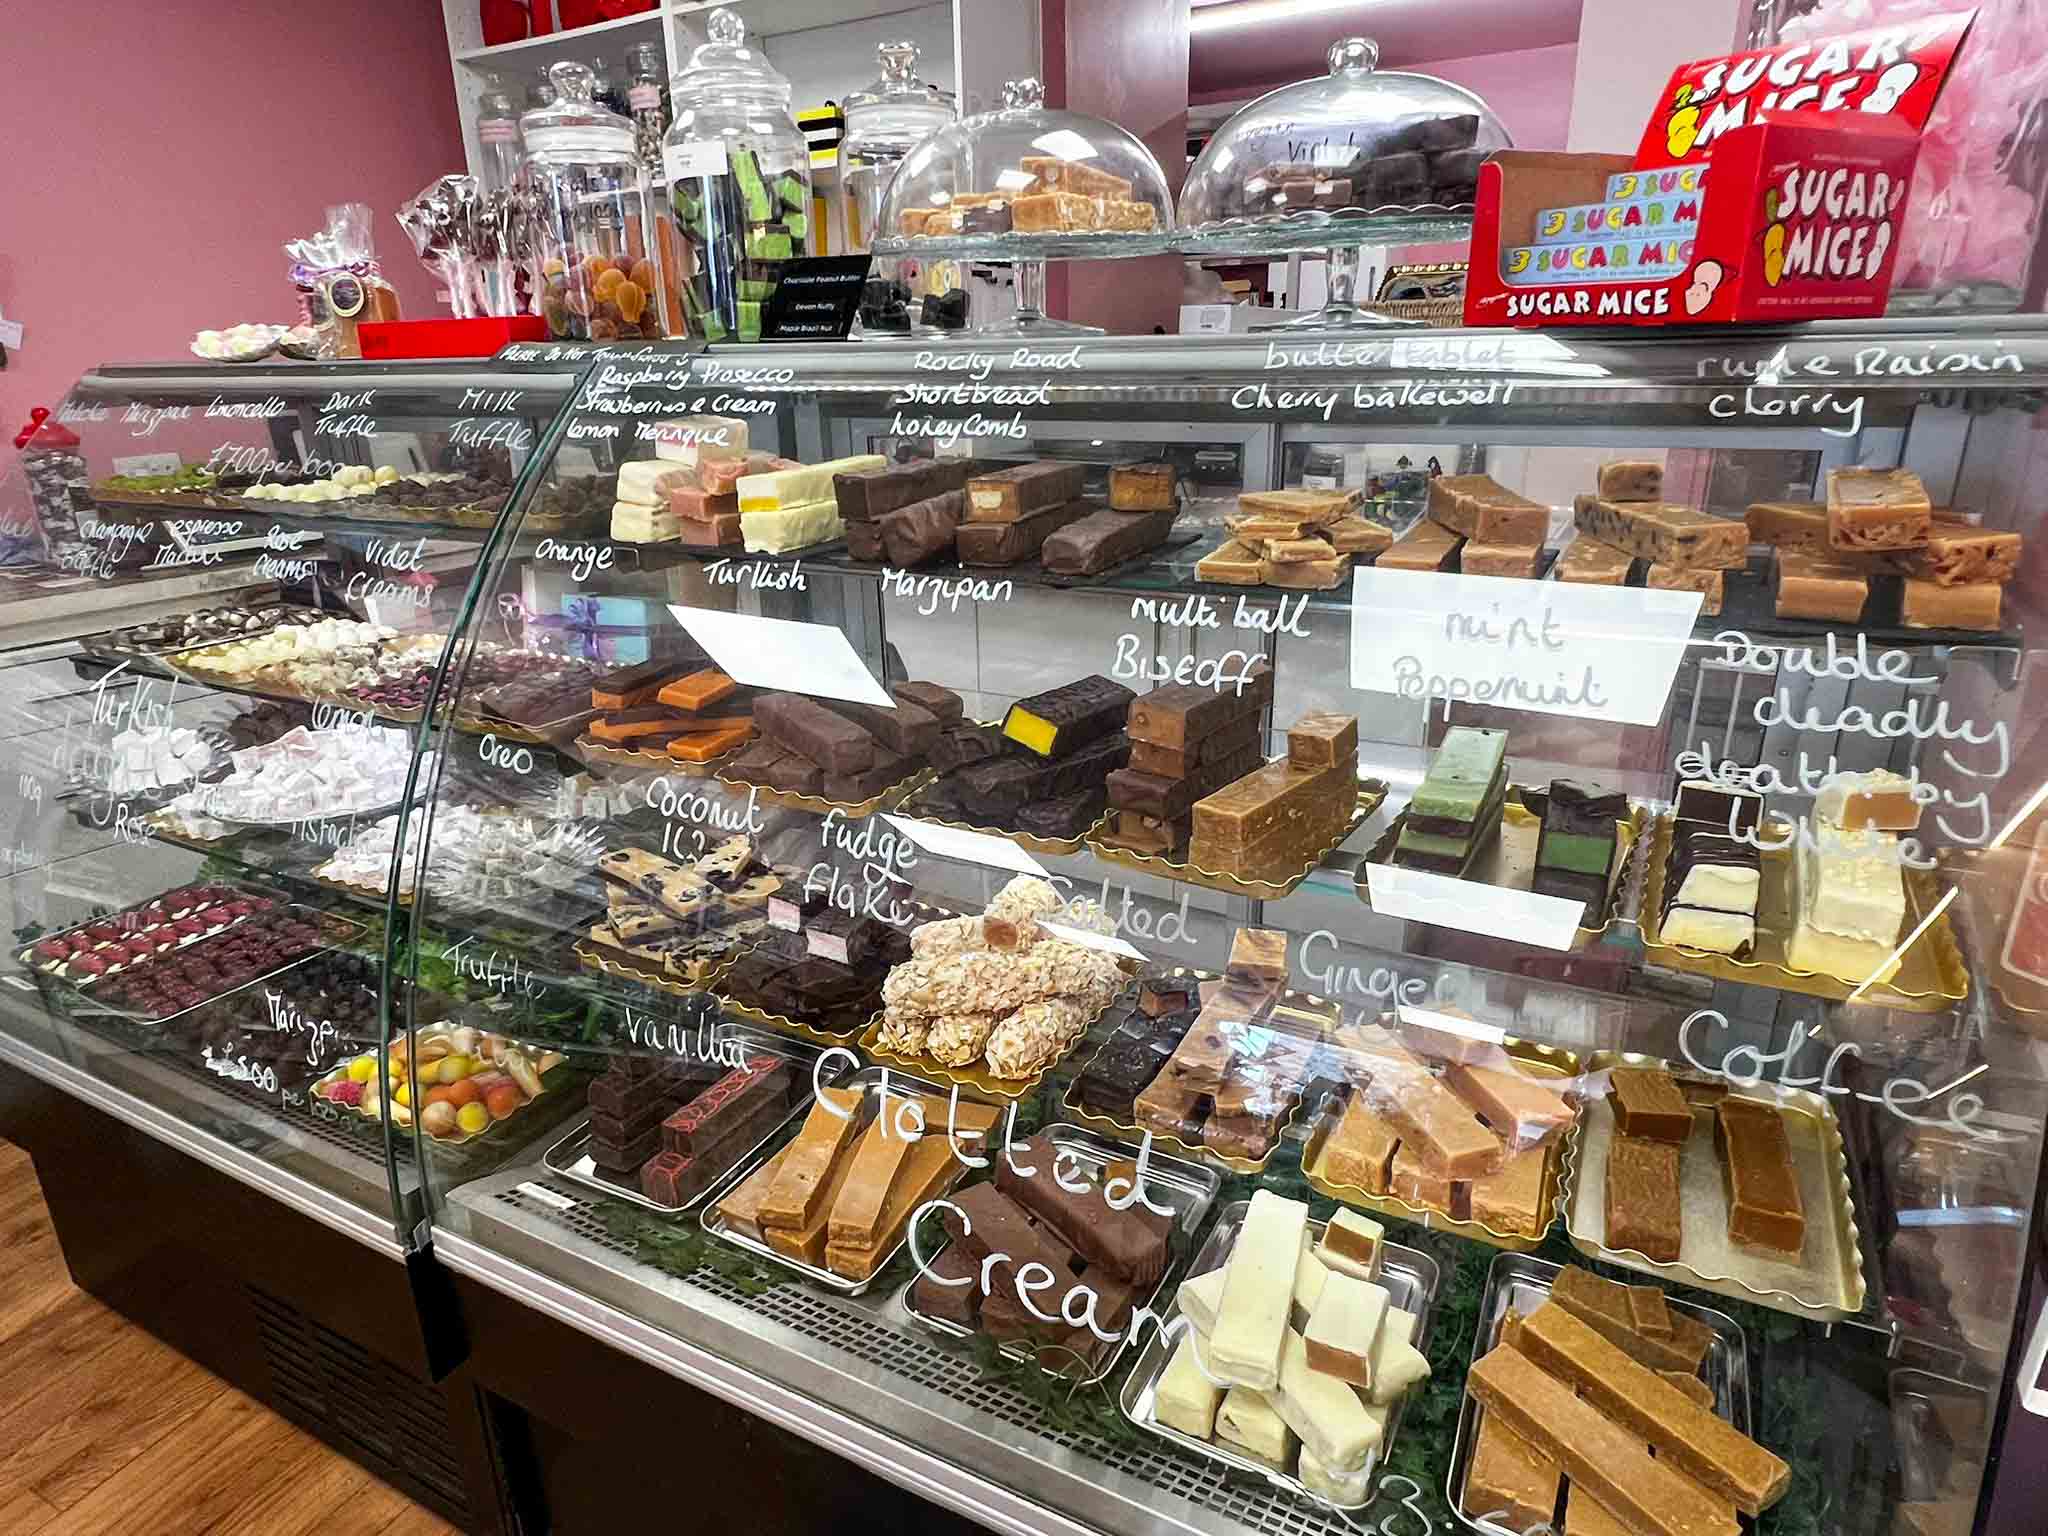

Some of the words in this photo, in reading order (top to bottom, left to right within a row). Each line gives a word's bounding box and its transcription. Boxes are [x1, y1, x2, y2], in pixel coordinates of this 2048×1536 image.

[1691, 35, 1913, 104] SUGAR
[1776, 168, 1890, 219] SUGAR
[1571, 202, 1665, 233] SUGAR
[1536, 243, 1630, 272] SUGAR
[1782, 226, 1869, 276] MICE
[1506, 289, 1590, 317] SUGAR
[1597, 287, 1669, 316] MICE
[702, 362, 794, 387] Prosecco
[1009, 346, 1081, 371] Road
[1855, 350, 2026, 377] Raisin
[712, 393, 777, 416] Cream
[896, 382, 1051, 407] Shortbread
[1231, 384, 1338, 422] Cherry
[314, 416, 378, 440] Truffle
[449, 421, 533, 450] Truffle
[535, 539, 616, 581] Orange
[702, 559, 808, 593] Turkish
[345, 571, 434, 608] Creams
[882, 563, 1014, 614] Marzipan
[1712, 630, 1940, 684] Double
[478, 733, 534, 775] Oreo
[645, 776, 765, 834] Coconut
[441, 936, 547, 1001] Truffle
[625, 1006, 753, 1074] Vanilla
[1678, 1009, 2030, 1143] Coffee
[813, 1047, 1177, 1216] Clotted
[908, 1199, 1232, 1388] Cream
